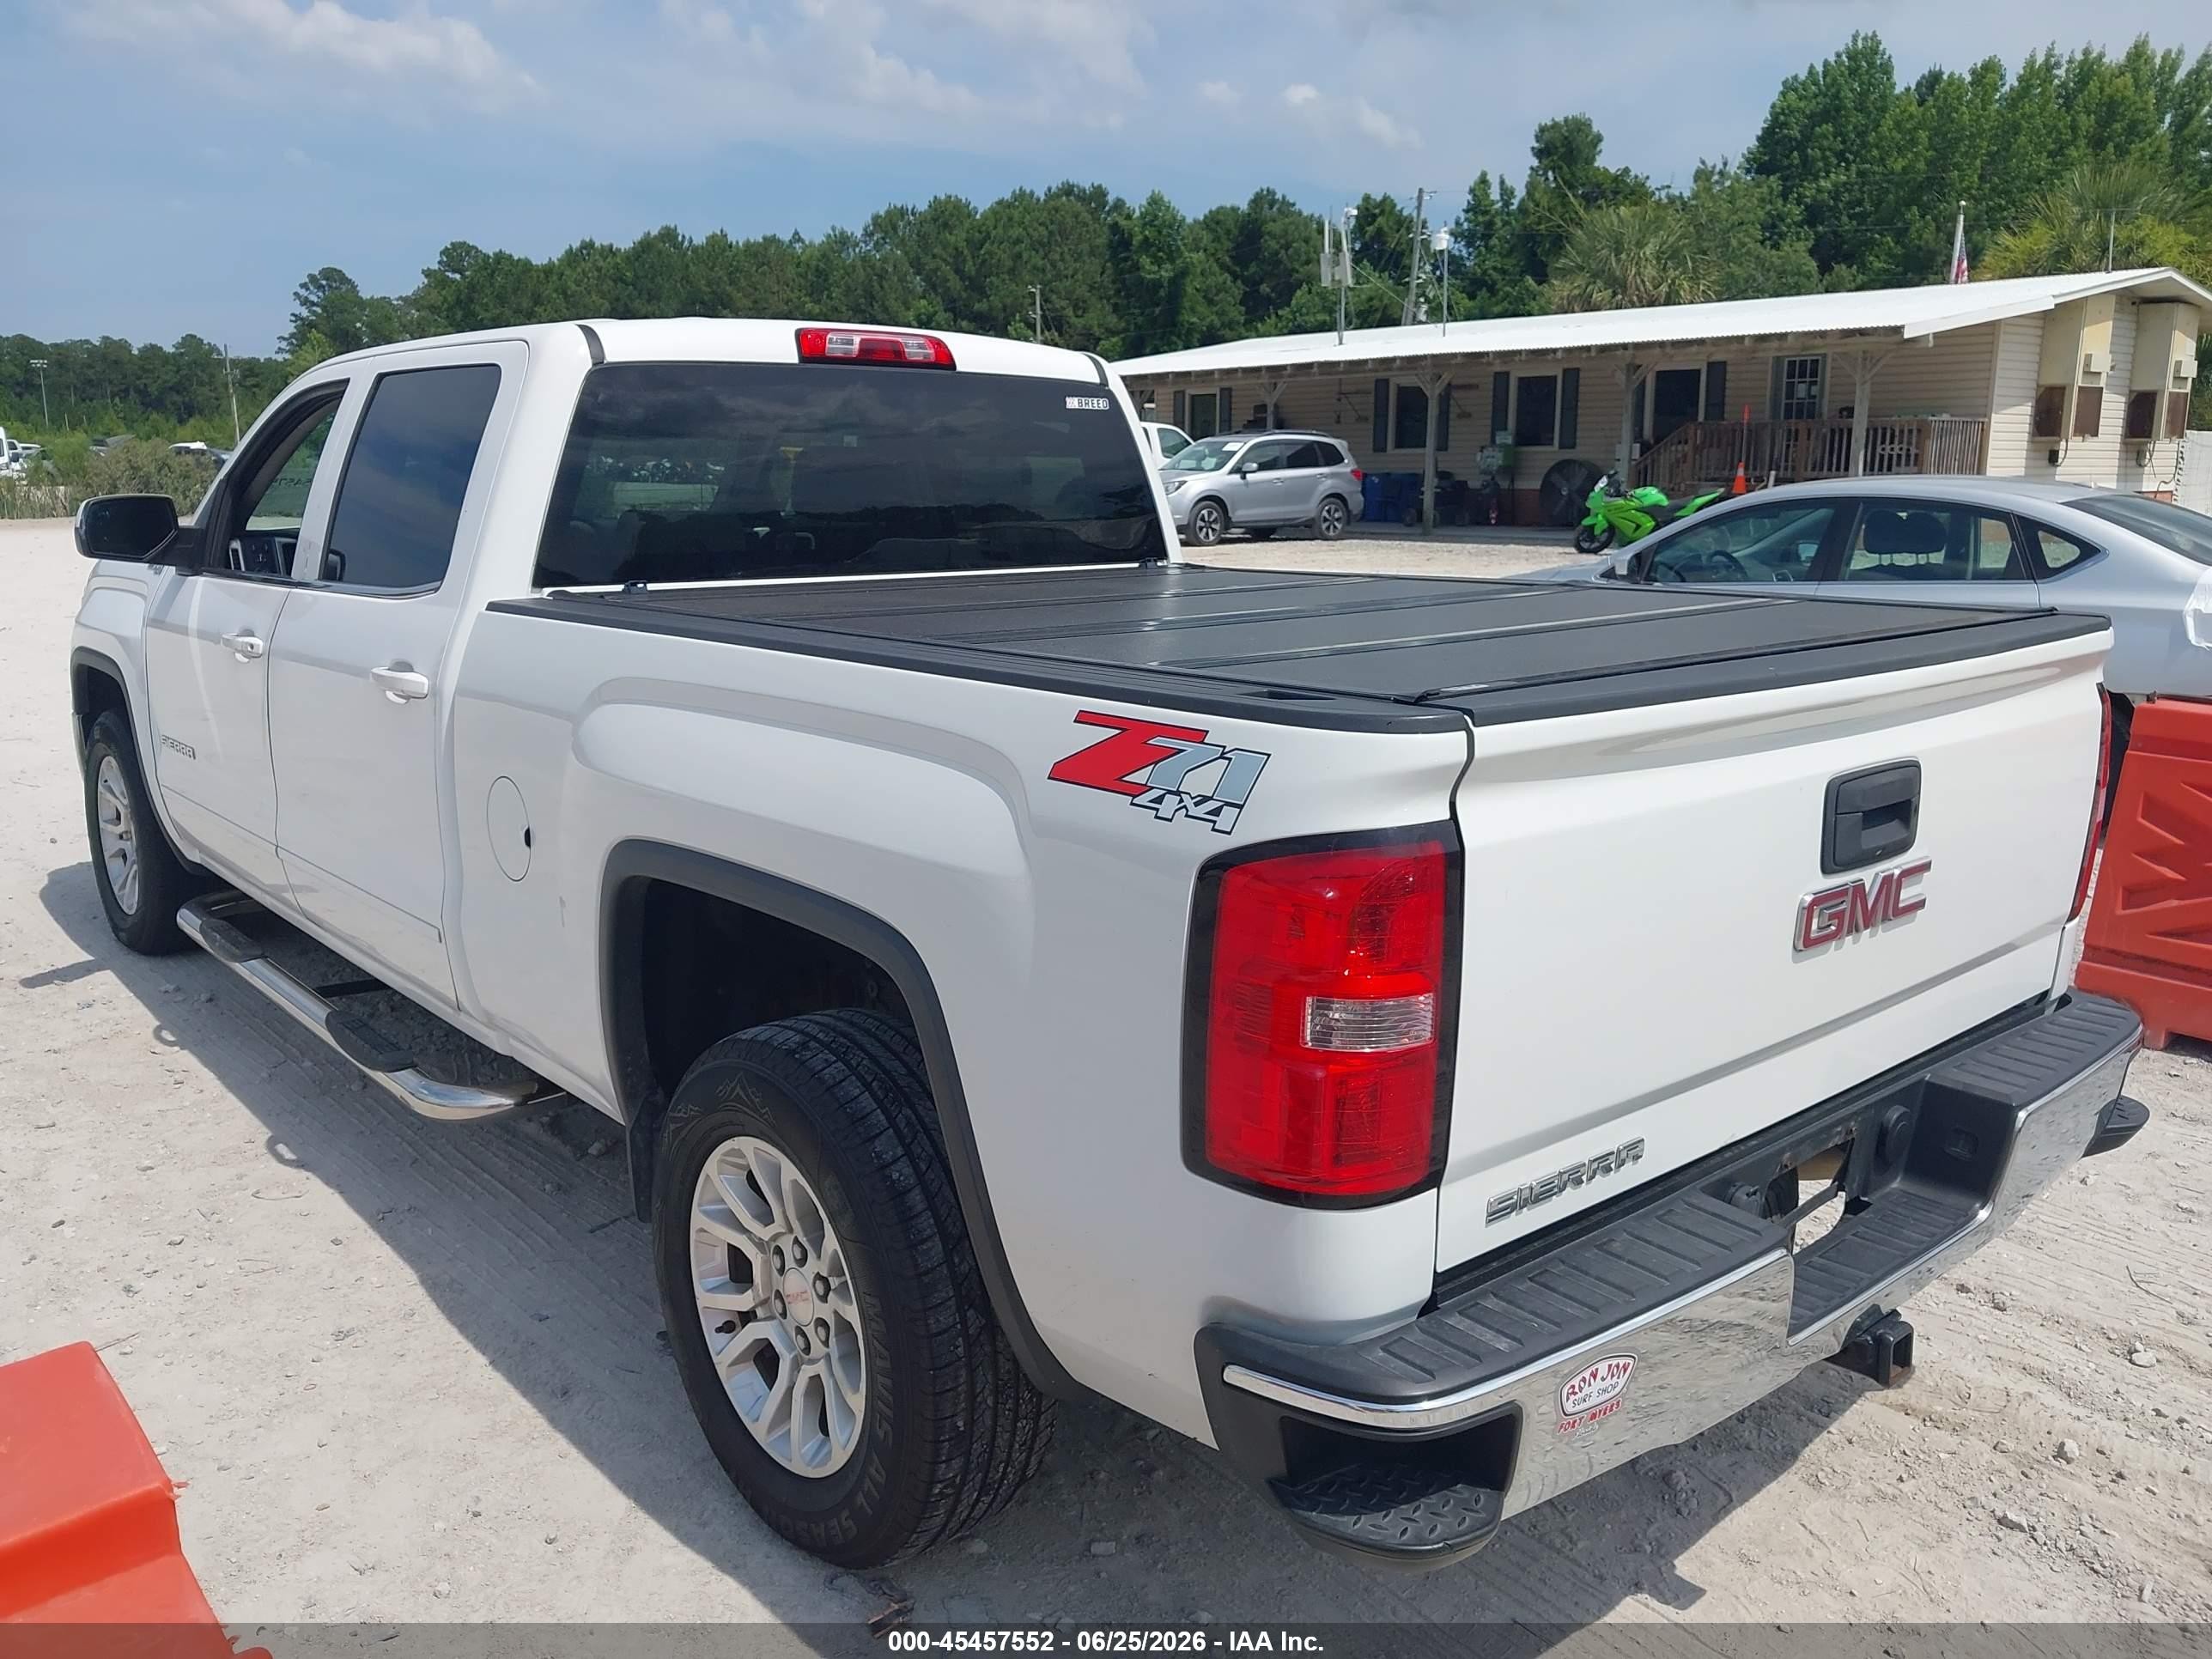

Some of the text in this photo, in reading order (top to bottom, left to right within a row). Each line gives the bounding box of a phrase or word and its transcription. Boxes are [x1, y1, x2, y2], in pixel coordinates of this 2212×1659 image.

[1047, 709, 1272, 809] Z71
[1794, 859, 1933, 951] GMC
[1486, 1137, 1645, 1225] SIERRA
[1565, 1361, 1632, 1403] RON JON
[1572, 1381, 1620, 1408] SURF SHOP
[1558, 1416, 1585, 1433] FORT
[1589, 1400, 1621, 1423] MYERS
